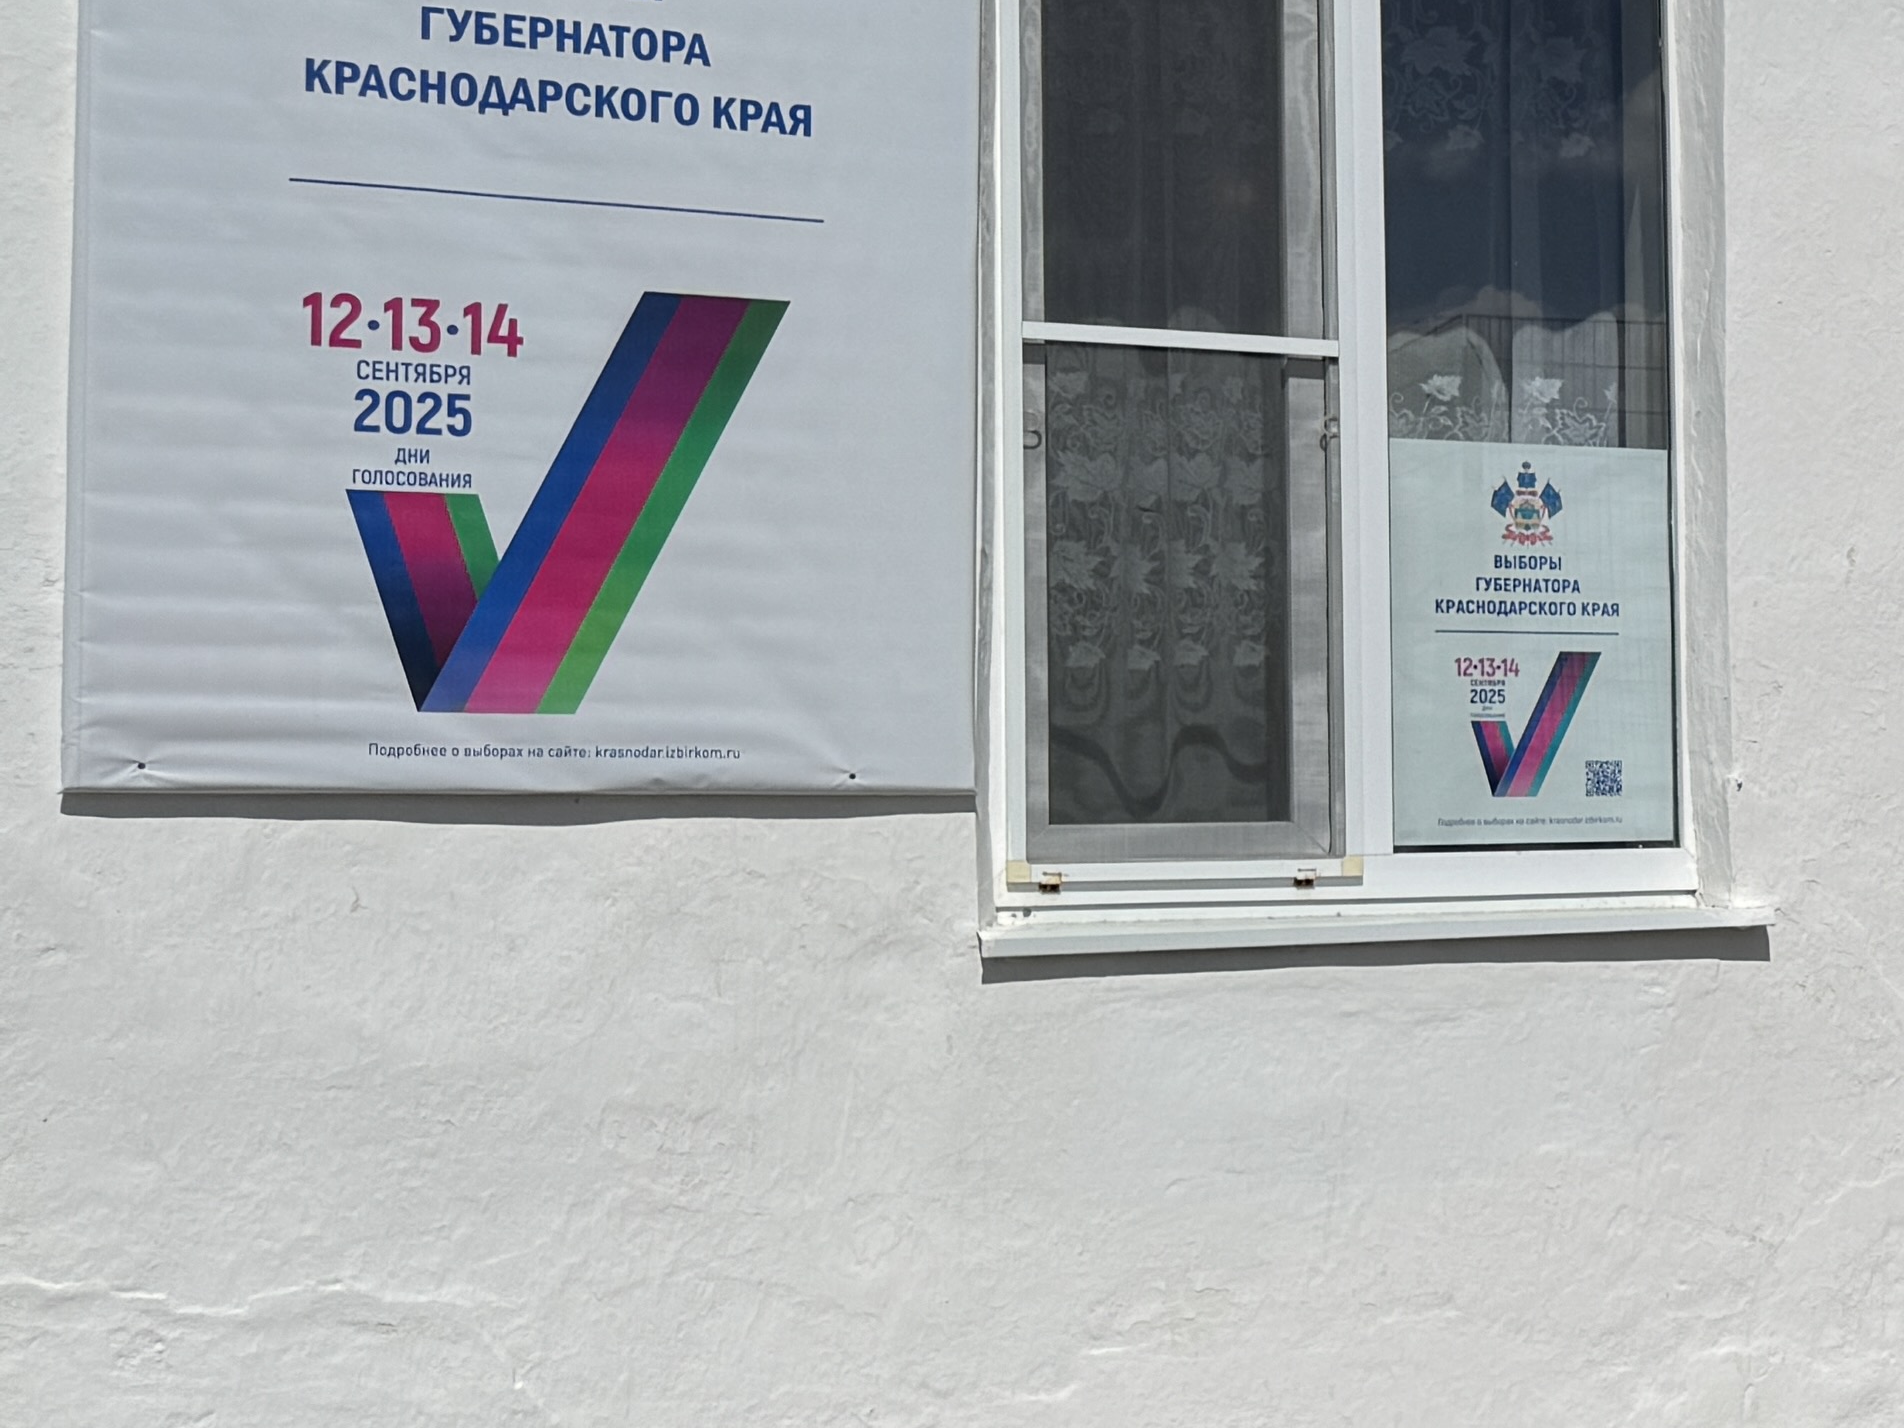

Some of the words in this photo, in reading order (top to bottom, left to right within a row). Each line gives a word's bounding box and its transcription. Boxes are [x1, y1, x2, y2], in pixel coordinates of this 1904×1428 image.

[420, 6, 712, 67] ГУБЕРНАТОРА
[304, 57, 700, 127] КРАСНОДАРСКОГО
[713, 96, 813, 138] КРАЯ
[356, 359, 471, 385] СЕНТЯБРЯ
[354, 388, 472, 437] 2025
[394, 448, 430, 465] ДНИ
[352, 469, 472, 488] ГОЛОСОВАНИЯ
[1494, 554, 1562, 571] ВЫБОРЫ
[1475, 576, 1581, 594] ГУБЕРНАТОРА
[1435, 599, 1577, 617] КРАСНОДАРСКОГО
[1581, 602, 1620, 617] КРАЯ
[1470, 689, 1506, 704] 2025
[368, 743, 447, 759] Подробнее
[451, 747, 460, 757] о
[464, 744, 523, 760] выборах
[527, 747, 544, 757] на
[548, 745, 591, 758] сайте:
